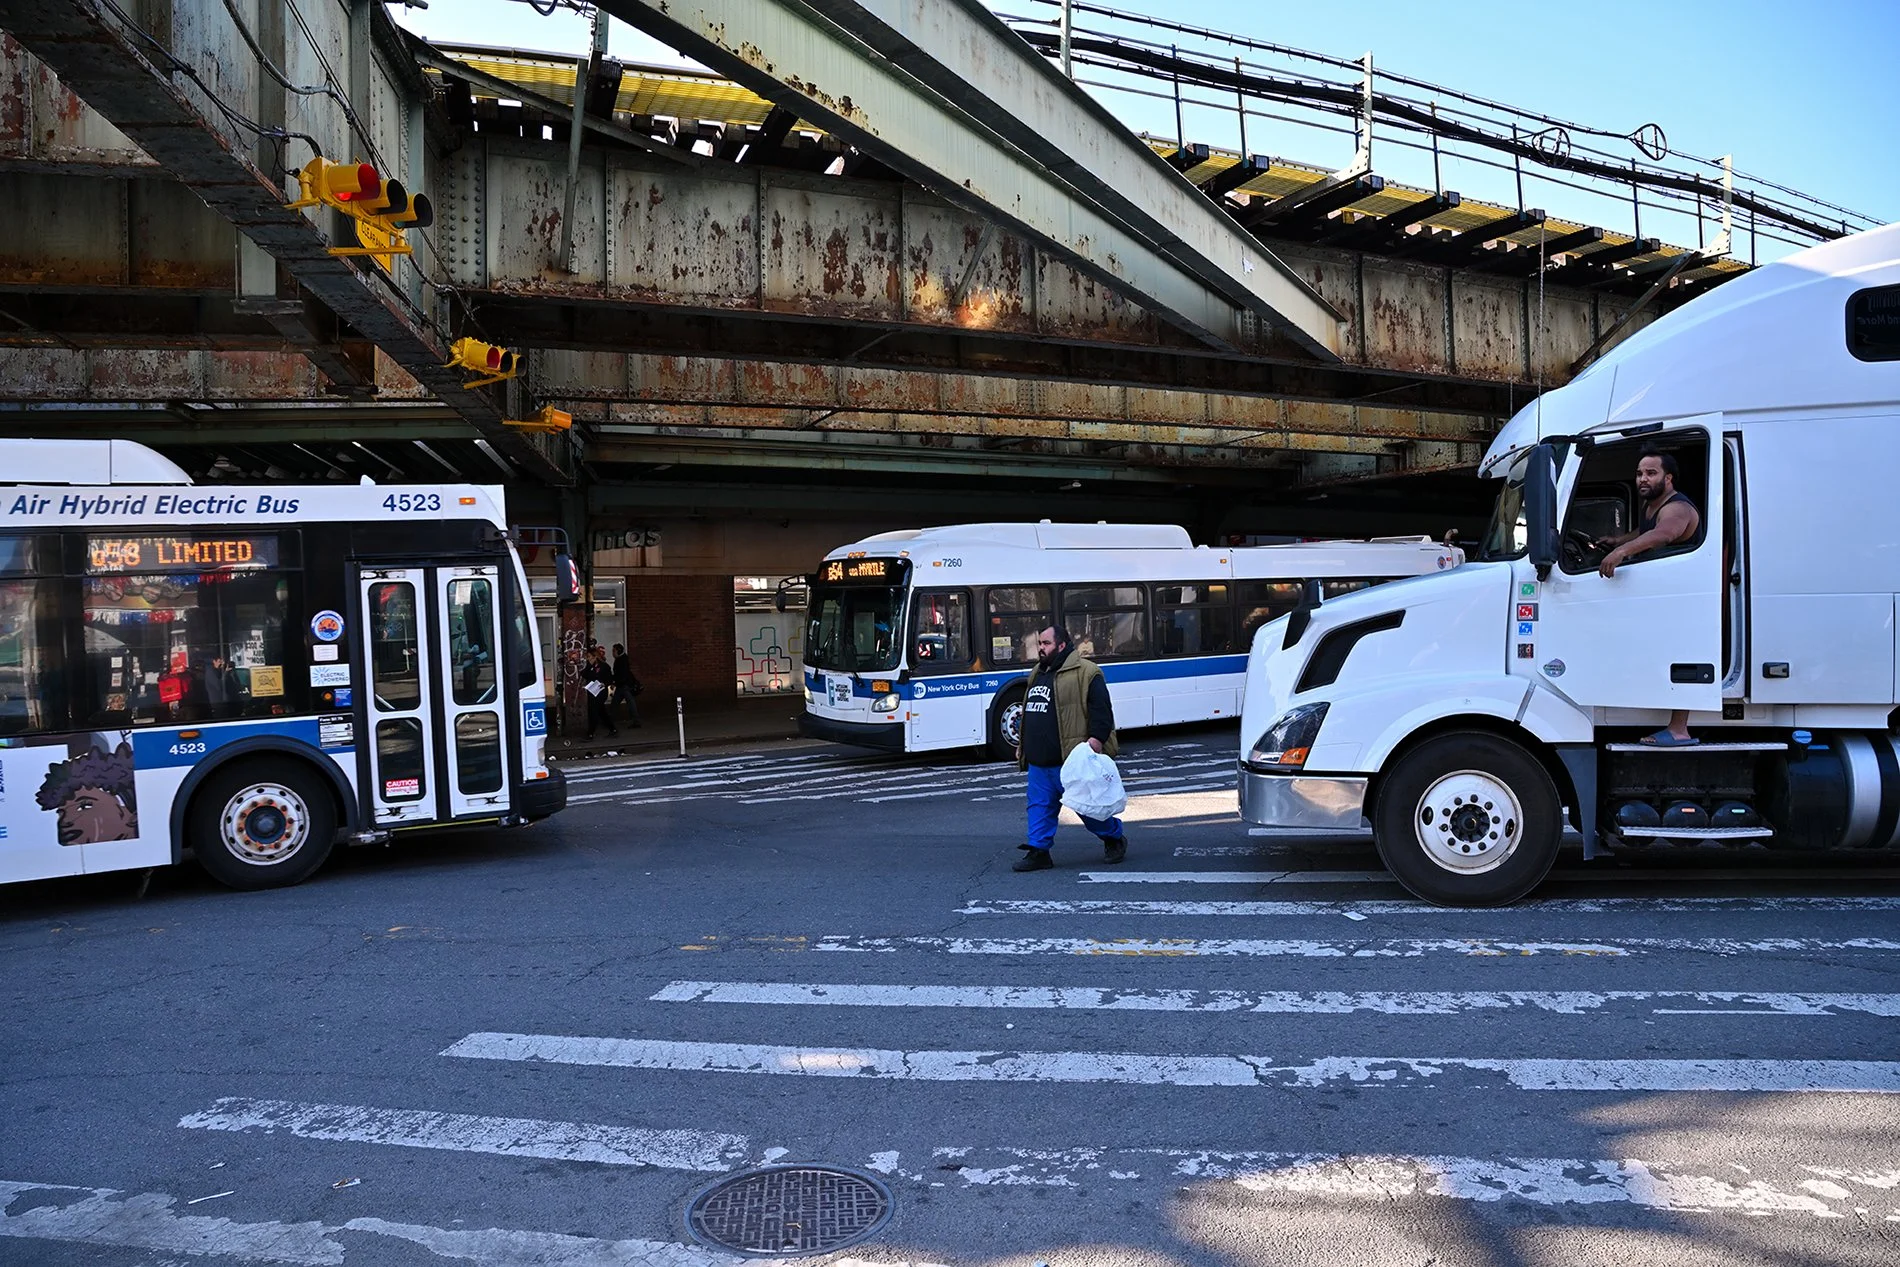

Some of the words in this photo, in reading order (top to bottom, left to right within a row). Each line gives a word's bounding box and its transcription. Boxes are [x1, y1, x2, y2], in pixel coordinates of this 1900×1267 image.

[8, 494, 51, 515] Air
[59, 494, 148, 520] Hybrid
[154, 494, 247, 514] Electric
[256, 495, 300, 514] Bus
[382, 494, 441, 512] 4523
[158, 540, 253, 564] LIMITED
[942, 558, 963, 568] 7260
[827, 561, 844, 581] B54
[858, 561, 886, 577] MYRTLE
[955, 684, 967, 692] City
[169, 742, 206, 755] 4523
[386, 779, 419, 788] CAUTION
